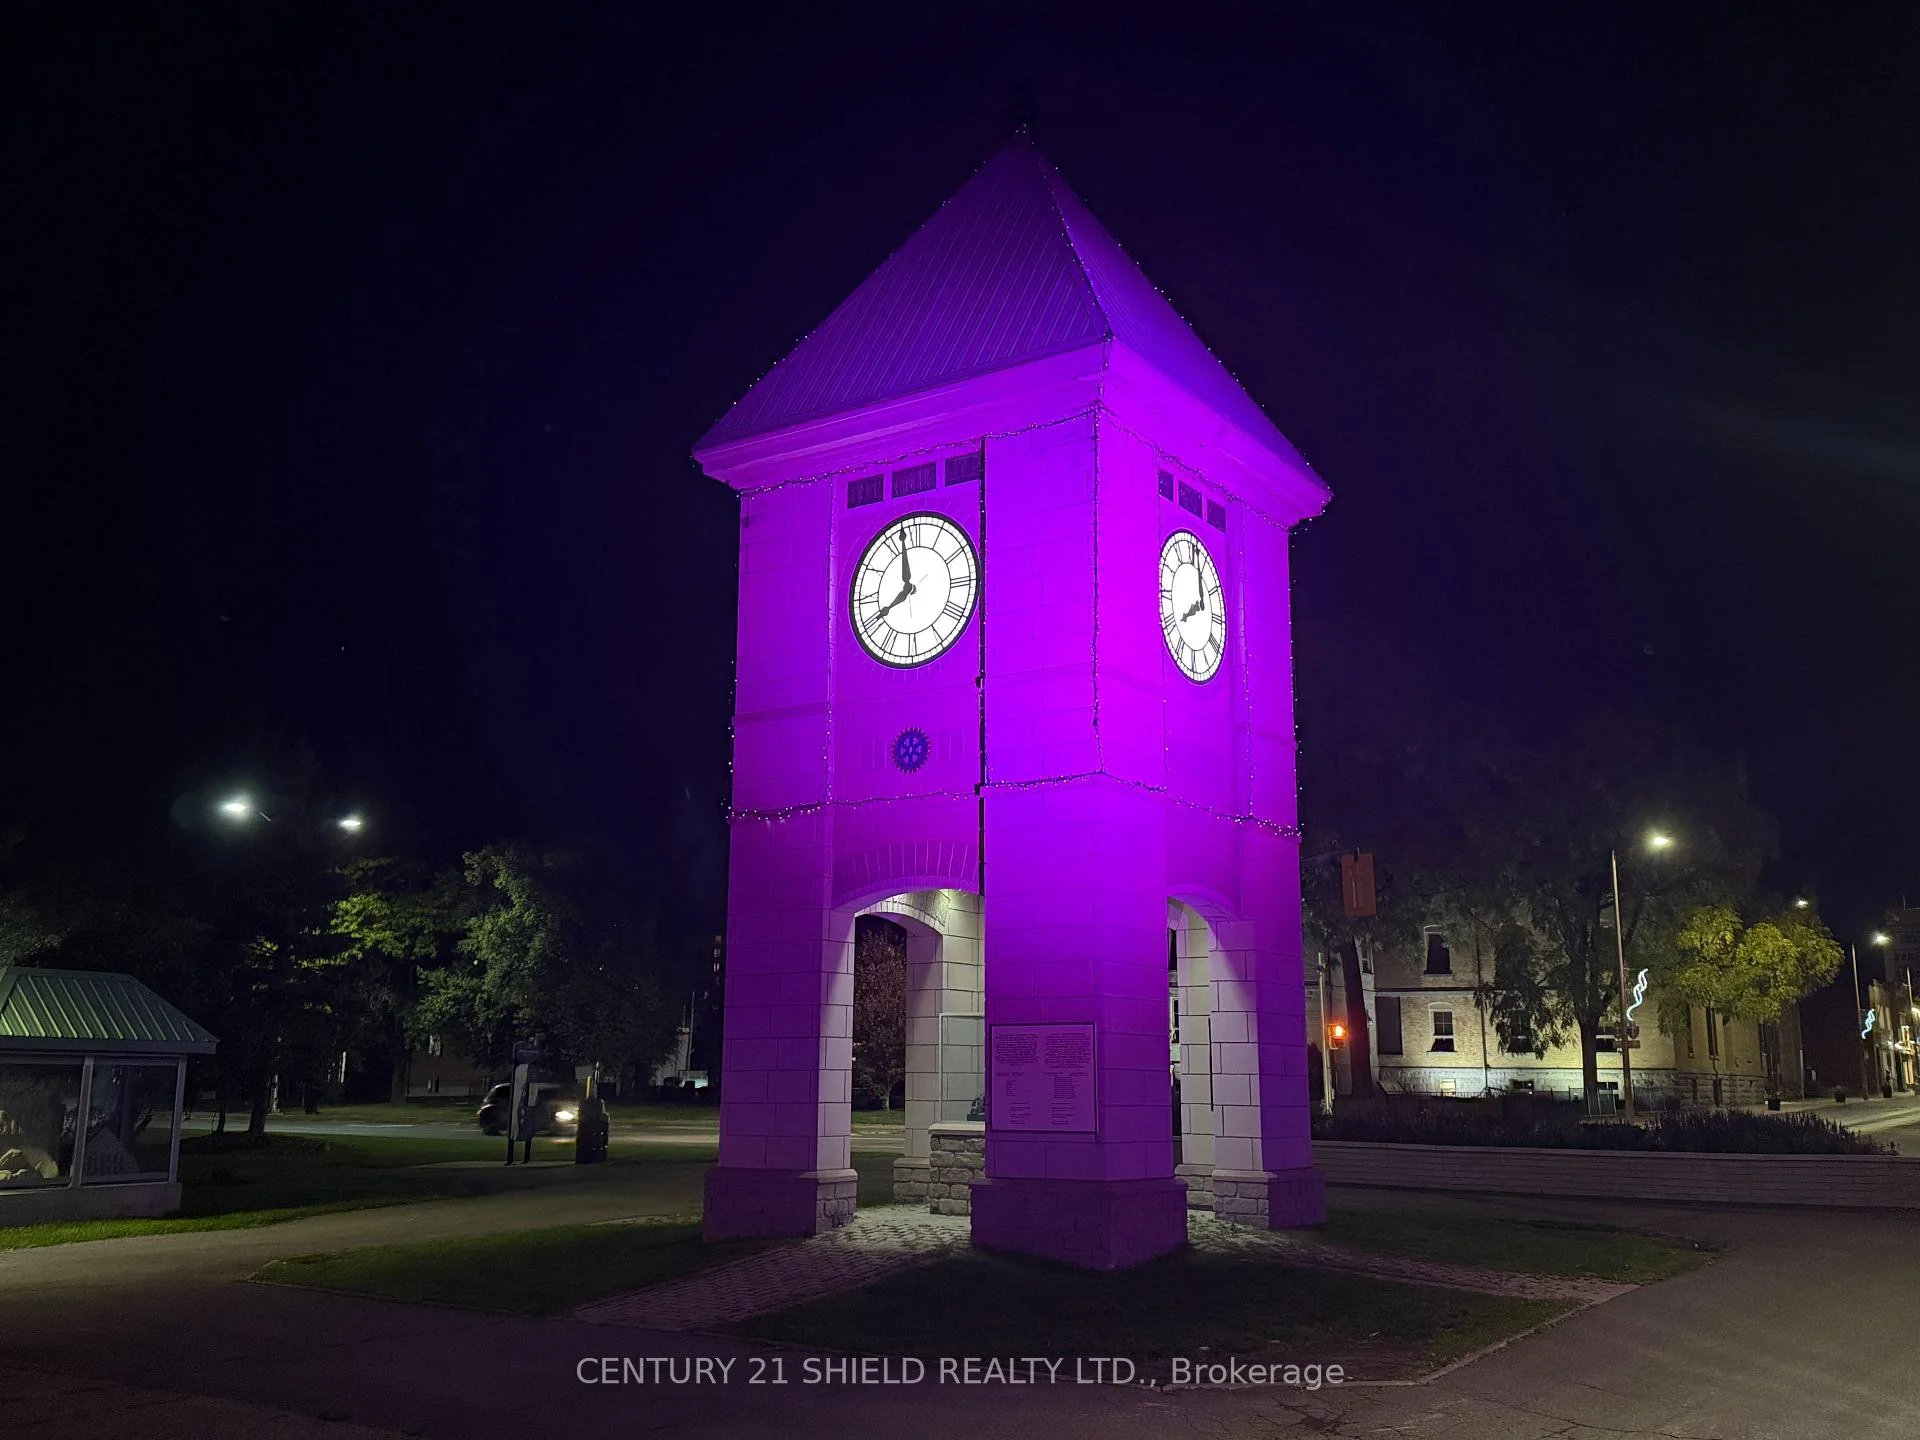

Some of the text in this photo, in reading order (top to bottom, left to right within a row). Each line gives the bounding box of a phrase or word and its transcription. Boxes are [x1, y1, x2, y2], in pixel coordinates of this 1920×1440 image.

[945, 547, 964, 565] II
[950, 576, 970, 588] III
[942, 601, 965, 621] IIII
[881, 628, 898, 654] VII
